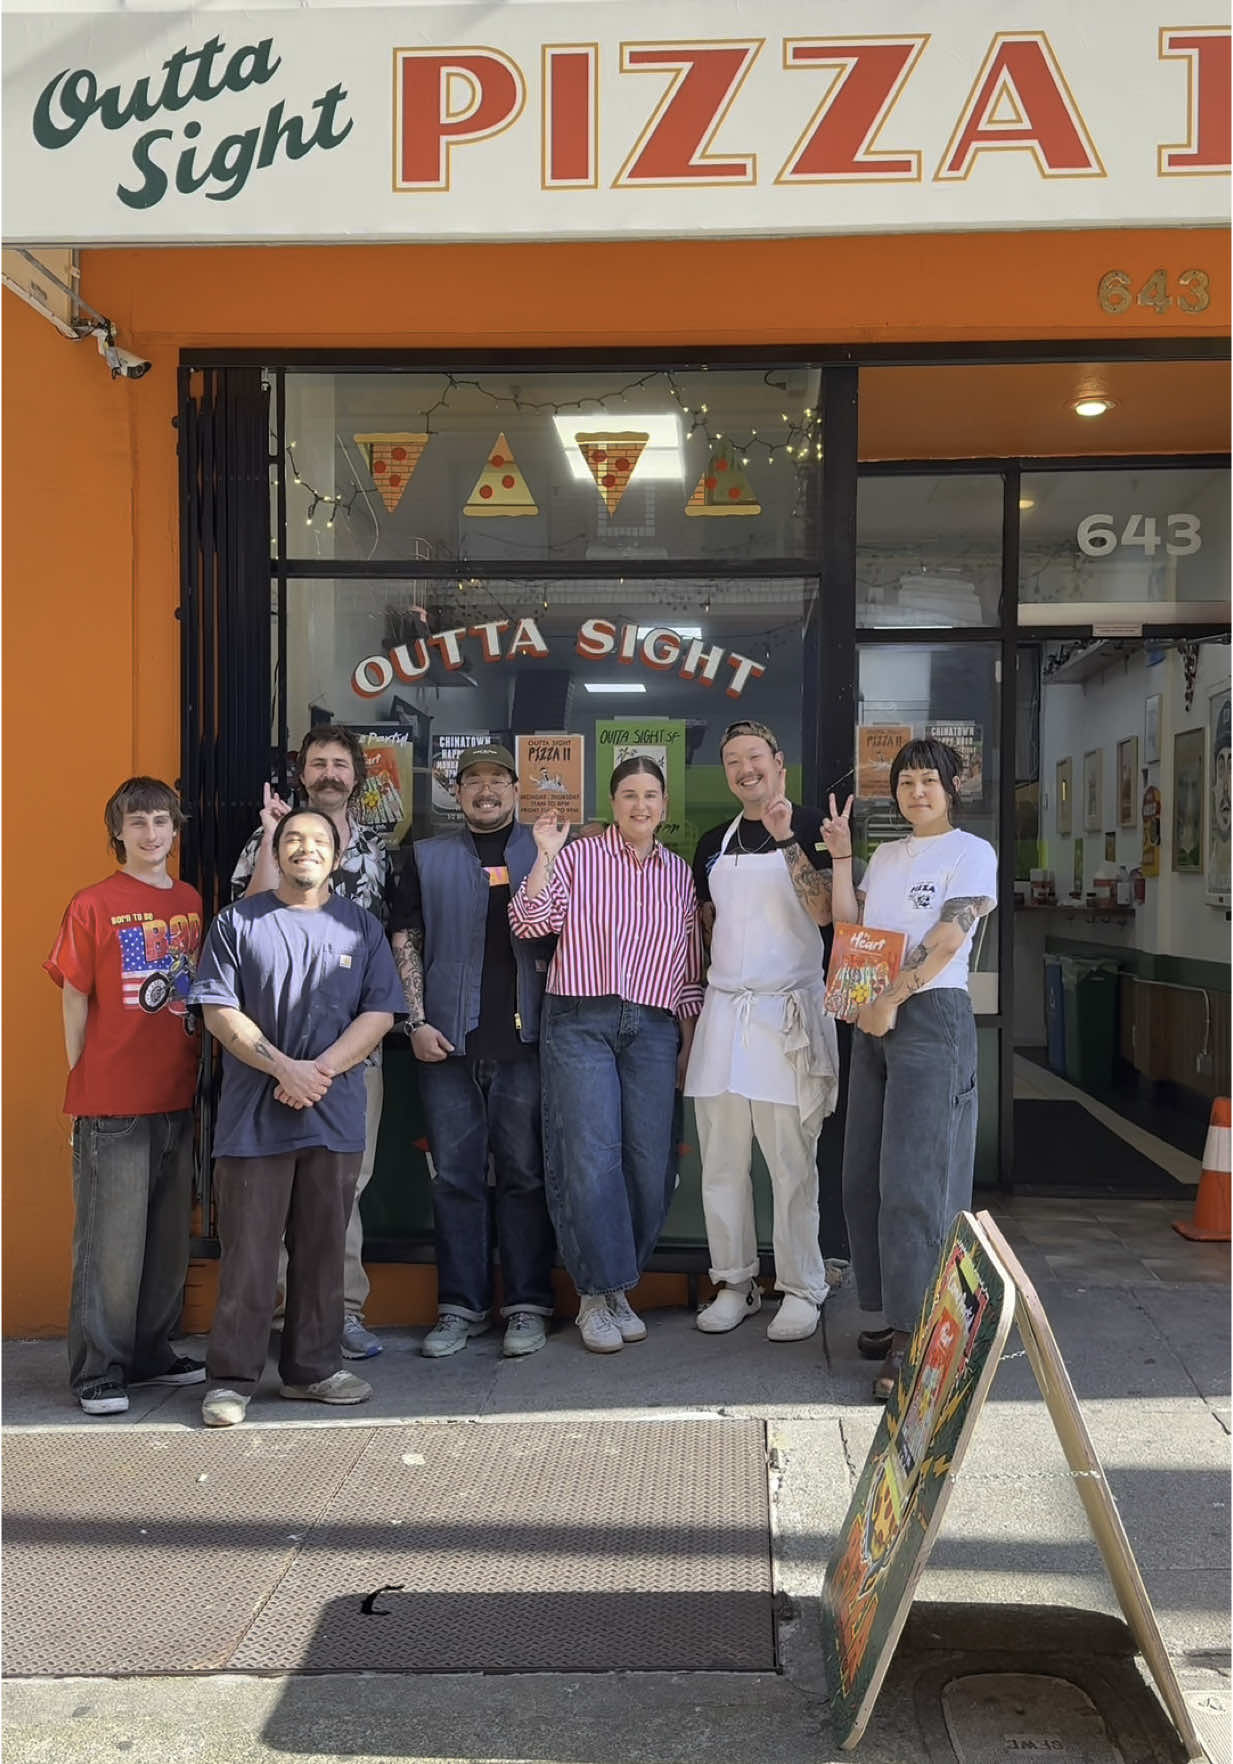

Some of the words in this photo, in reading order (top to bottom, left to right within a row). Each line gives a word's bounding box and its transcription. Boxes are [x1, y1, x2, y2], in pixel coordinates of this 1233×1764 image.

[33, 33, 281, 149] Outta
[392, 30, 1108, 192] PIZZA
[116, 82, 354, 210] Sight
[1096, 268, 1211, 315] 643
[1076, 513, 1202, 556] 643
[351, 617, 549, 699] OUTTA
[576, 618, 766, 699] SIGHT
[440, 736, 491, 748] CHINATOWN
[528, 747, 560, 761] PIZZA
[563, 747, 571, 760] II
[600, 729, 630, 744] OUTTA
[632, 728, 664, 744] SIGHT
[931, 727, 975, 736] CHINATOWN
